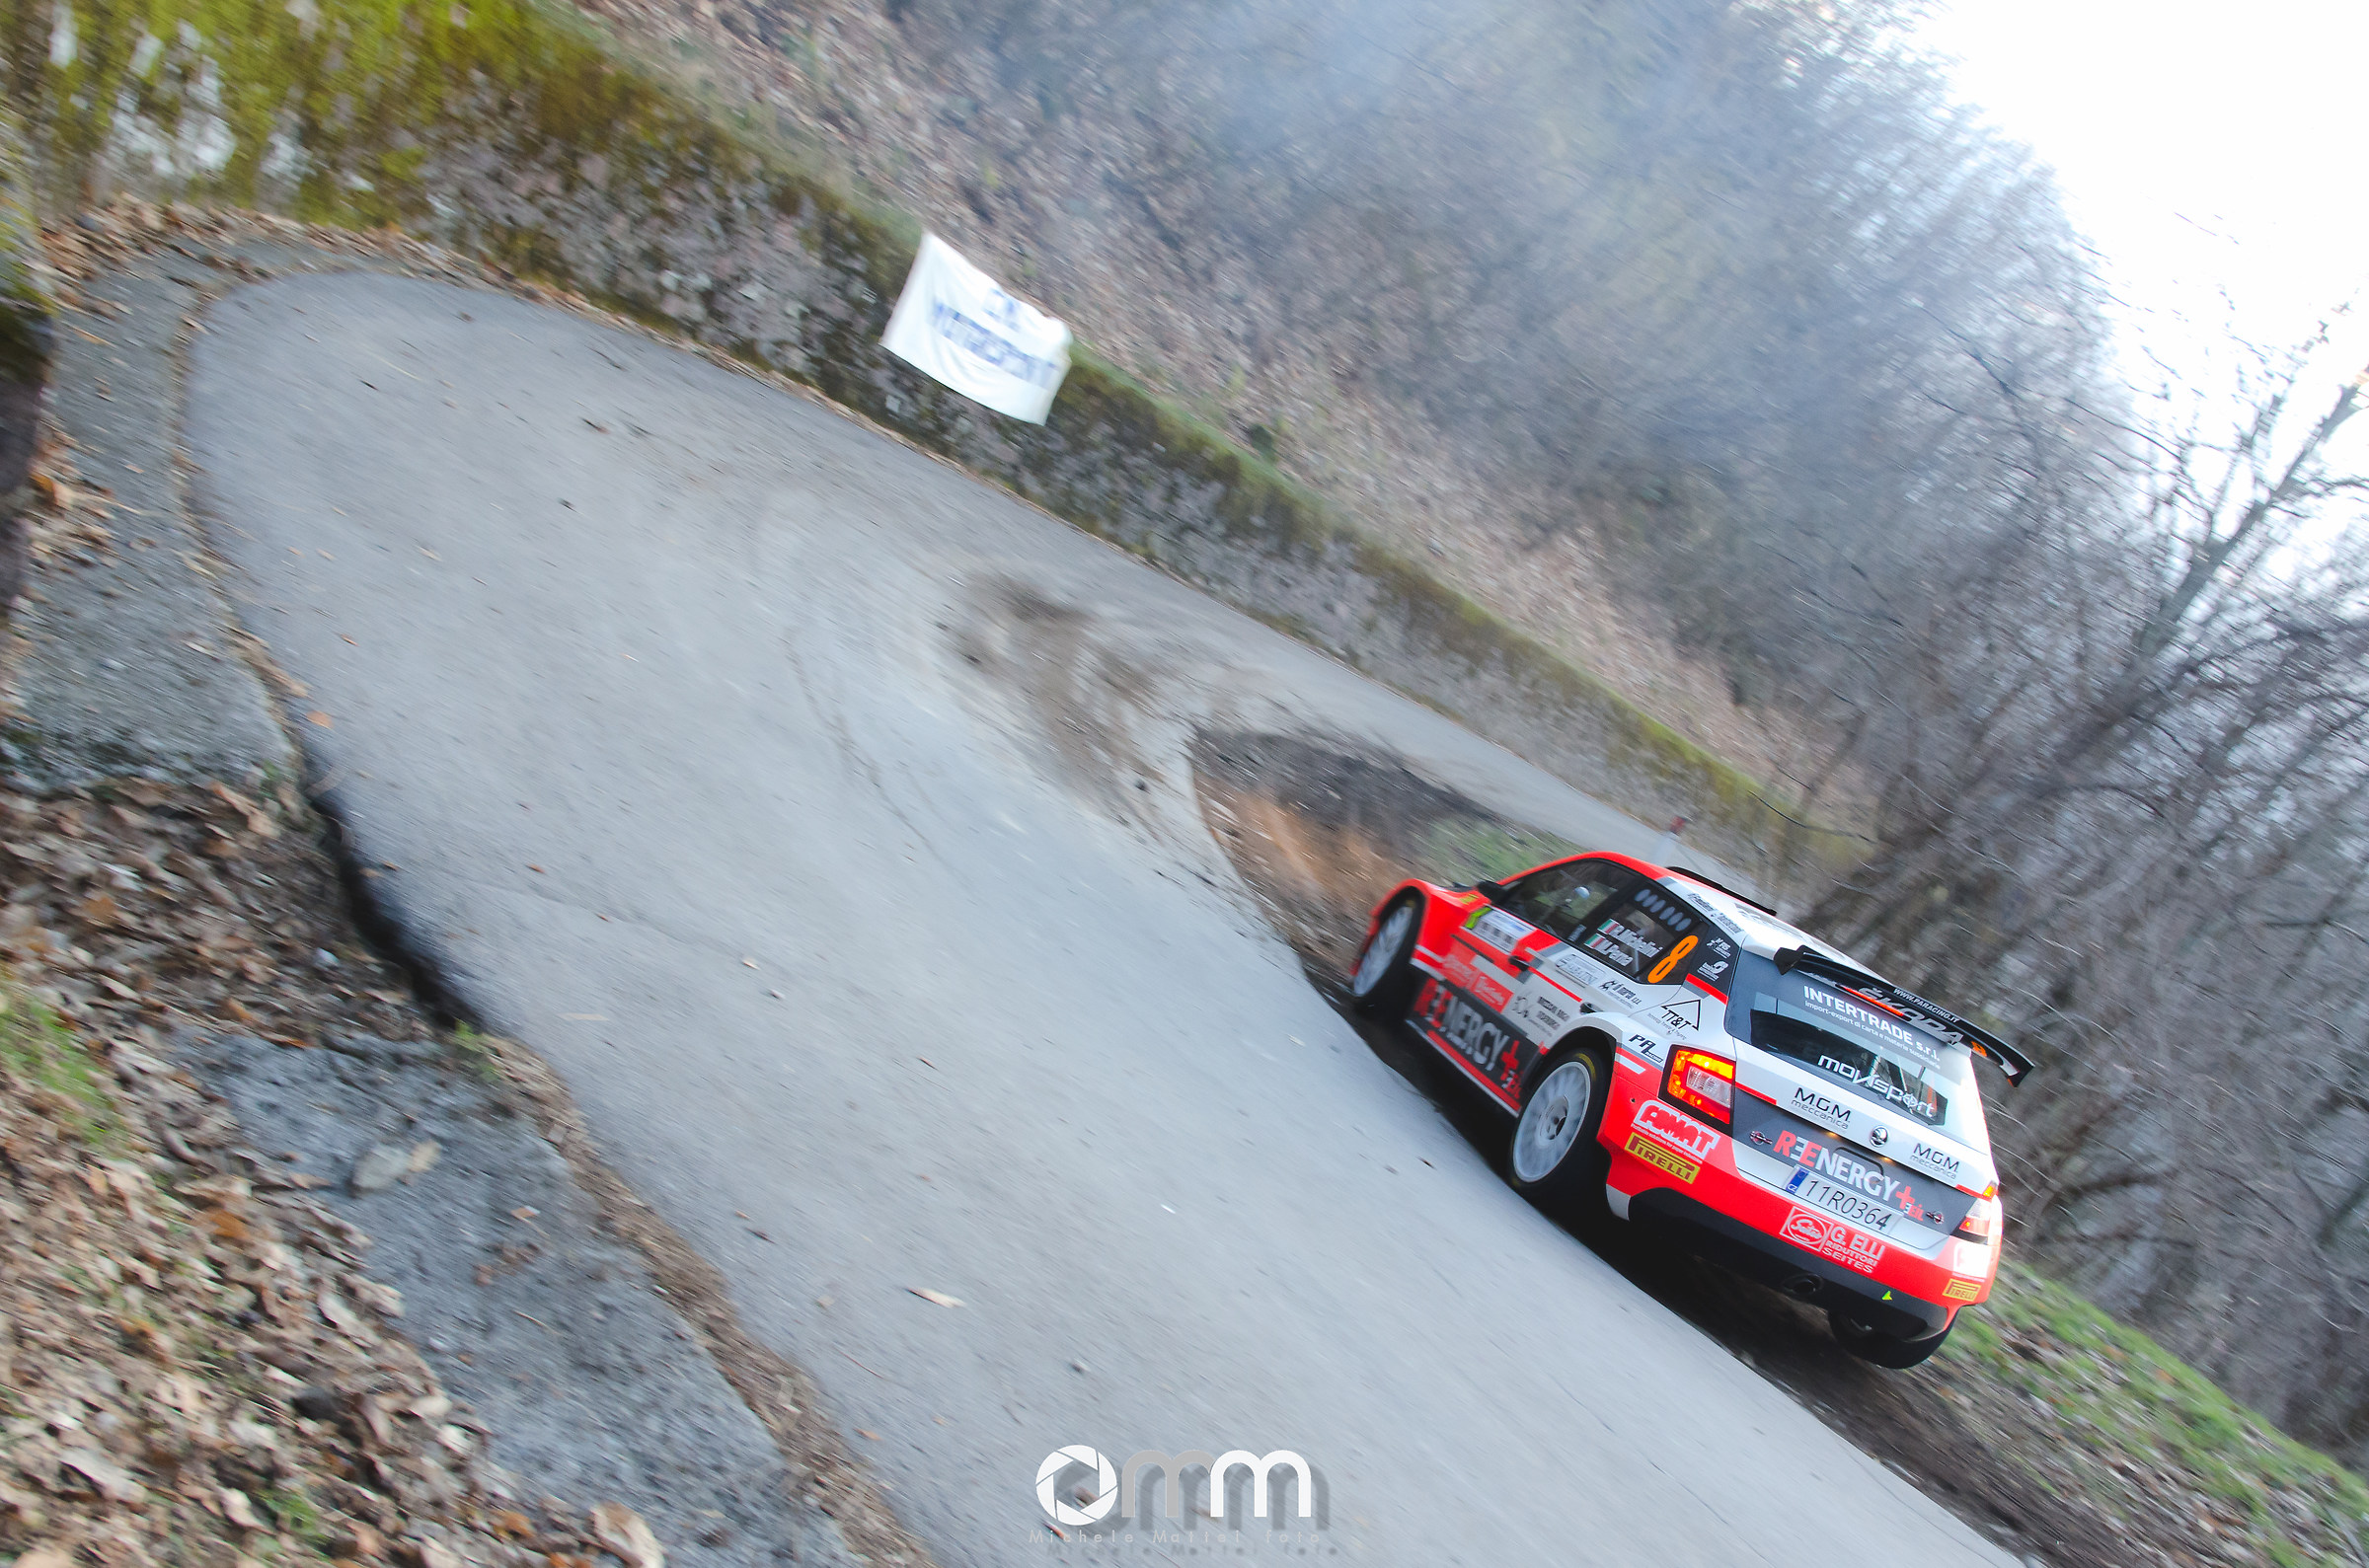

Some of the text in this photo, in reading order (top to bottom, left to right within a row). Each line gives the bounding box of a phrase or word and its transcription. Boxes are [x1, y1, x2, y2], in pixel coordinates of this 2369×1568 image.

[1647, 934, 1699, 984] 8
[1661, 1009, 1692, 1030] TT&T
[1803, 985, 1913, 1046] INTERTRADE
[1817, 1054, 1936, 1119] movisport
[1791, 1099, 1849, 1130] meccanica
[1629, 1135, 1695, 1180] PIRELLI
[1909, 1154, 1956, 1180] meccanica
[1806, 1180, 1892, 1231] 11R0364
[1822, 1247, 1873, 1273] SEITES
[1825, 1240, 1878, 1266] RIDUTTORI
[1849, 1233, 1886, 1261] ELLI
